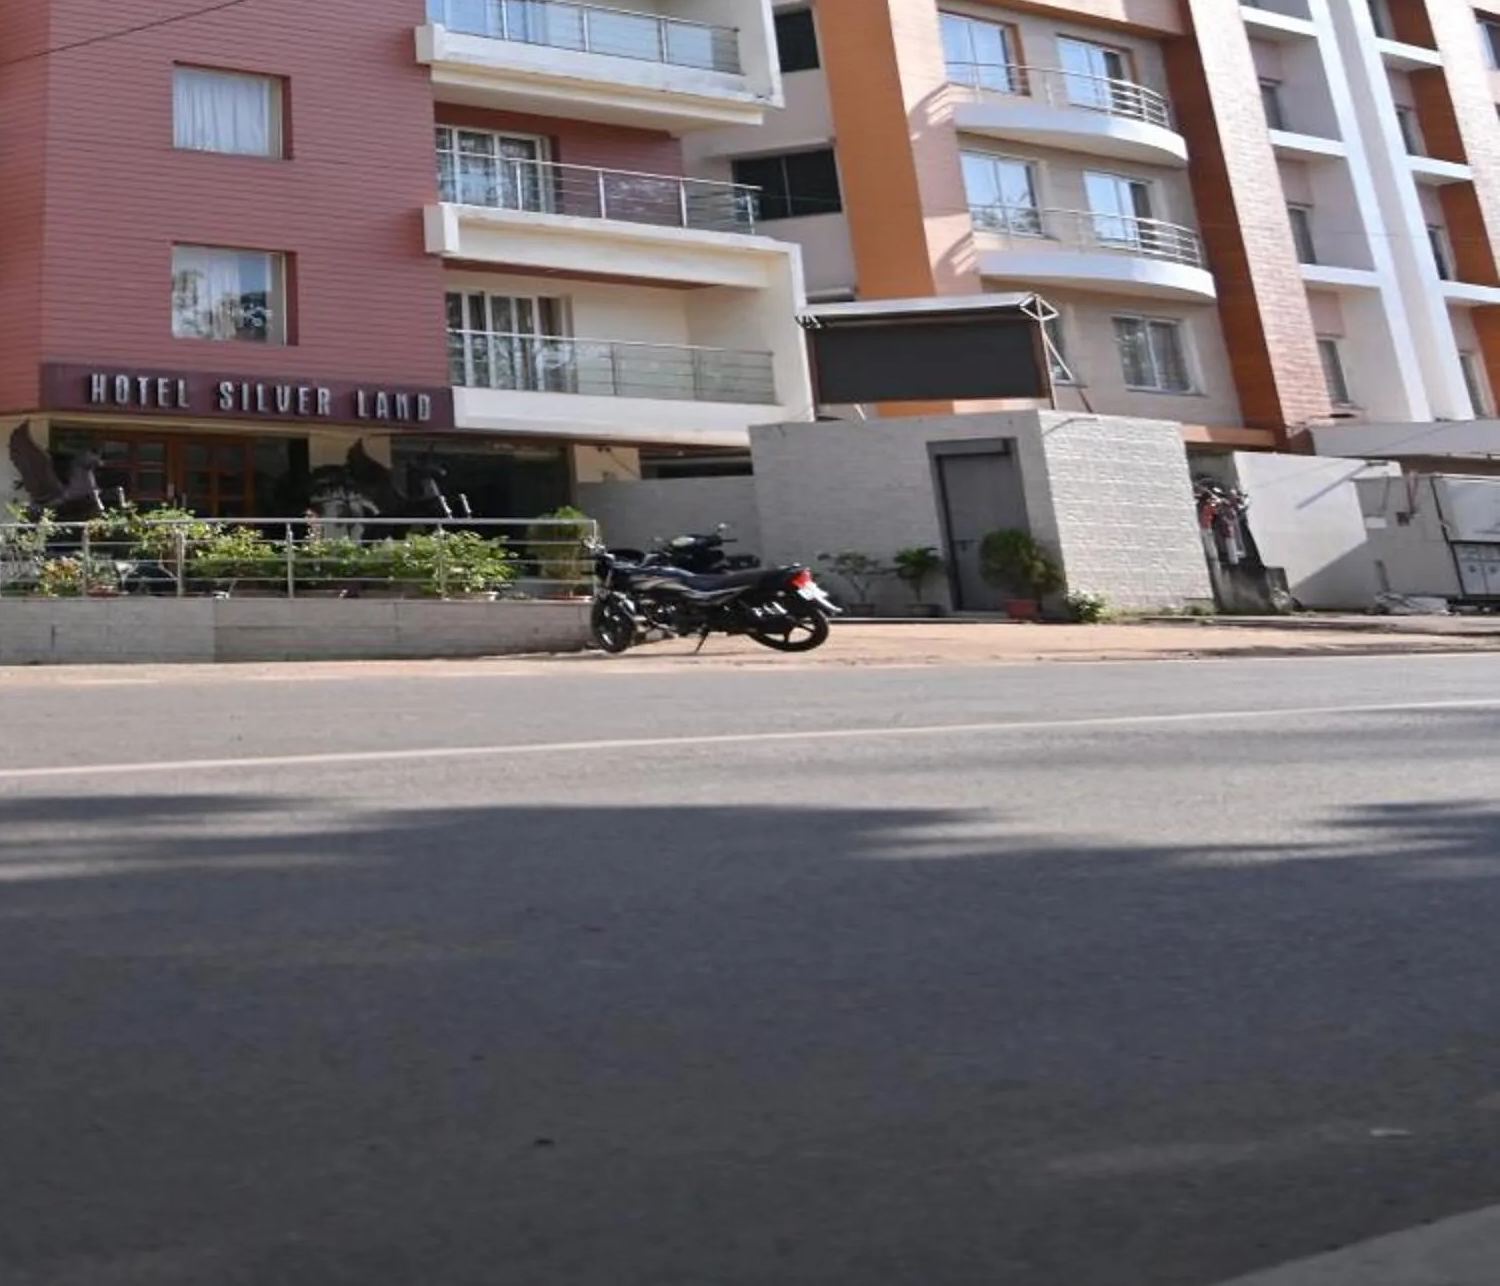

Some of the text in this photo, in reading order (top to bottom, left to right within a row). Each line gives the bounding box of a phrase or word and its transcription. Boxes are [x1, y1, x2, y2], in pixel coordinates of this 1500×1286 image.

[90, 373, 433, 421] HOTEL SILVER LAND
